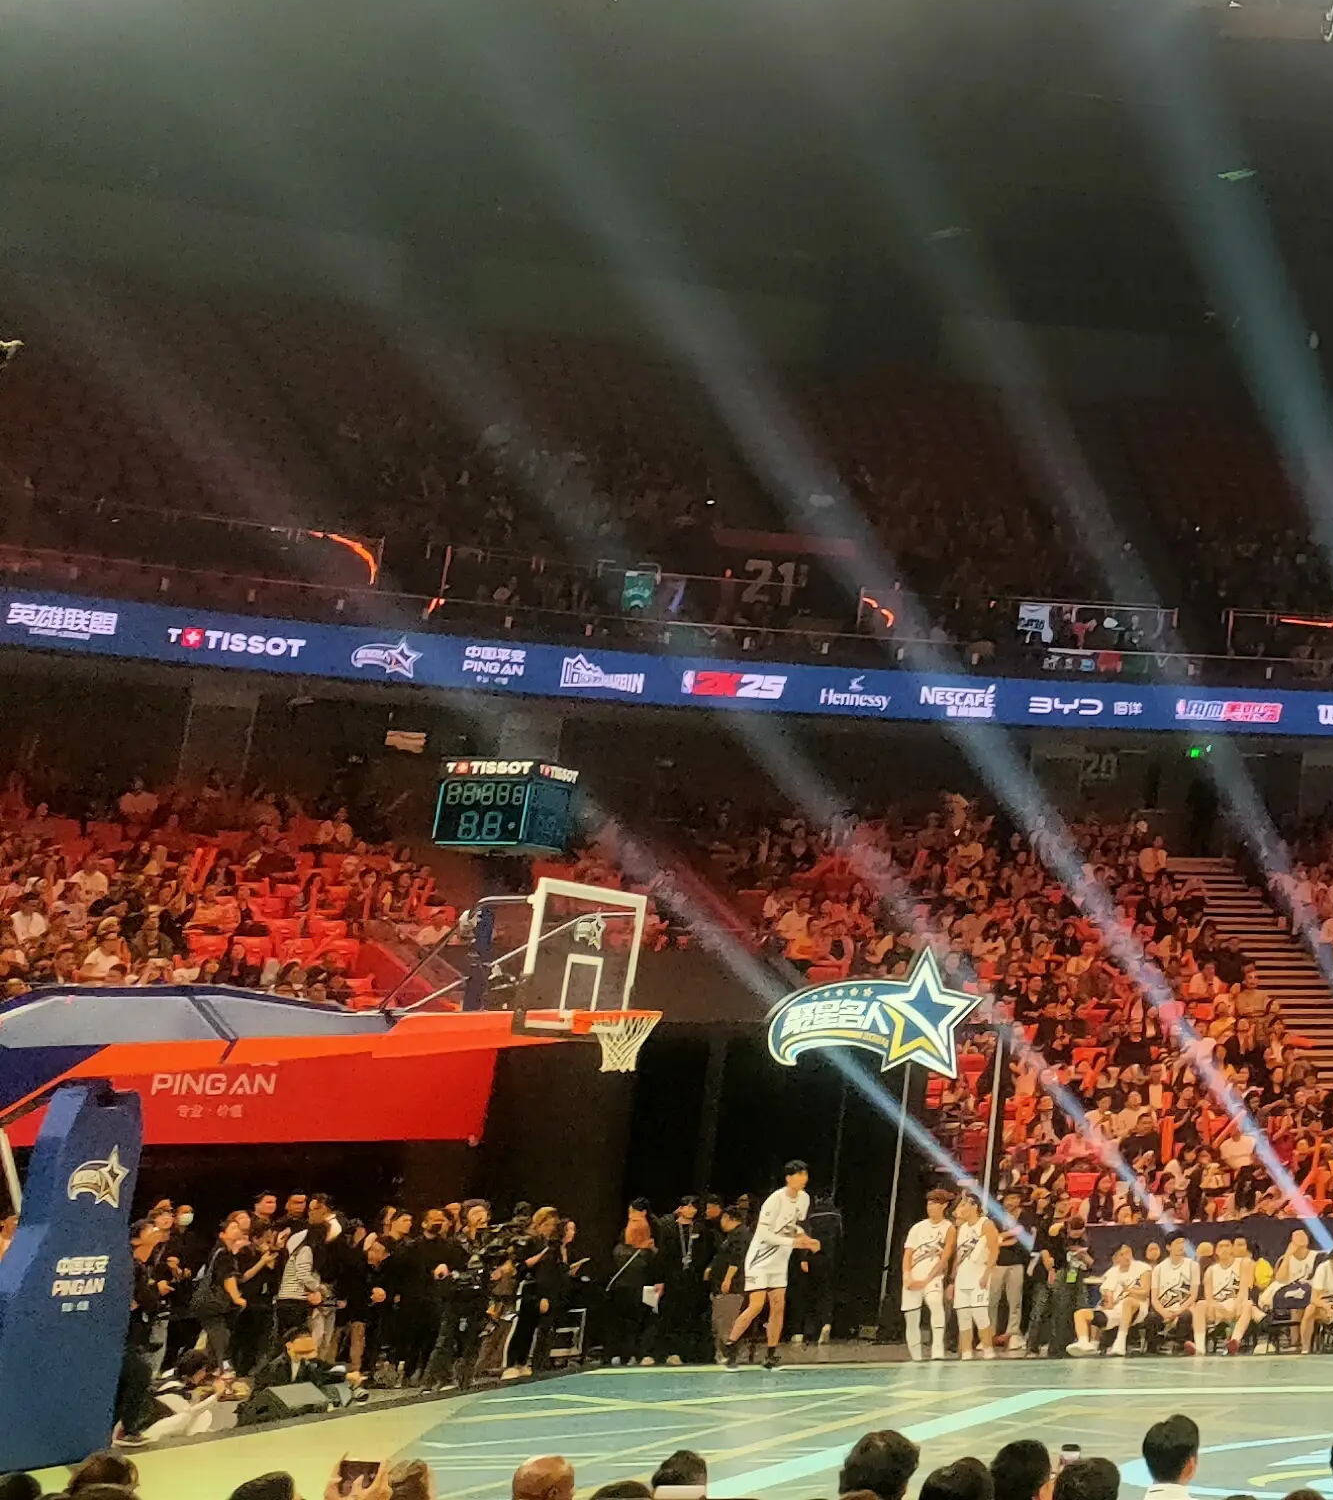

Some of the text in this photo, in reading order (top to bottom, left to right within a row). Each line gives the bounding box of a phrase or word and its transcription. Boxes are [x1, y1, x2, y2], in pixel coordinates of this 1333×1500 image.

[741, 559, 796, 606] 21
[6, 602, 118, 636] 英雄联盟
[205, 630, 307, 658] TISSOT
[820, 688, 892, 711] Hennessy
[920, 683, 997, 707] NESCAFÉ
[1028, 696, 1104, 715] BYD
[470, 761, 533, 775] TISSOT
[780, 999, 890, 1039] 聚星名人
